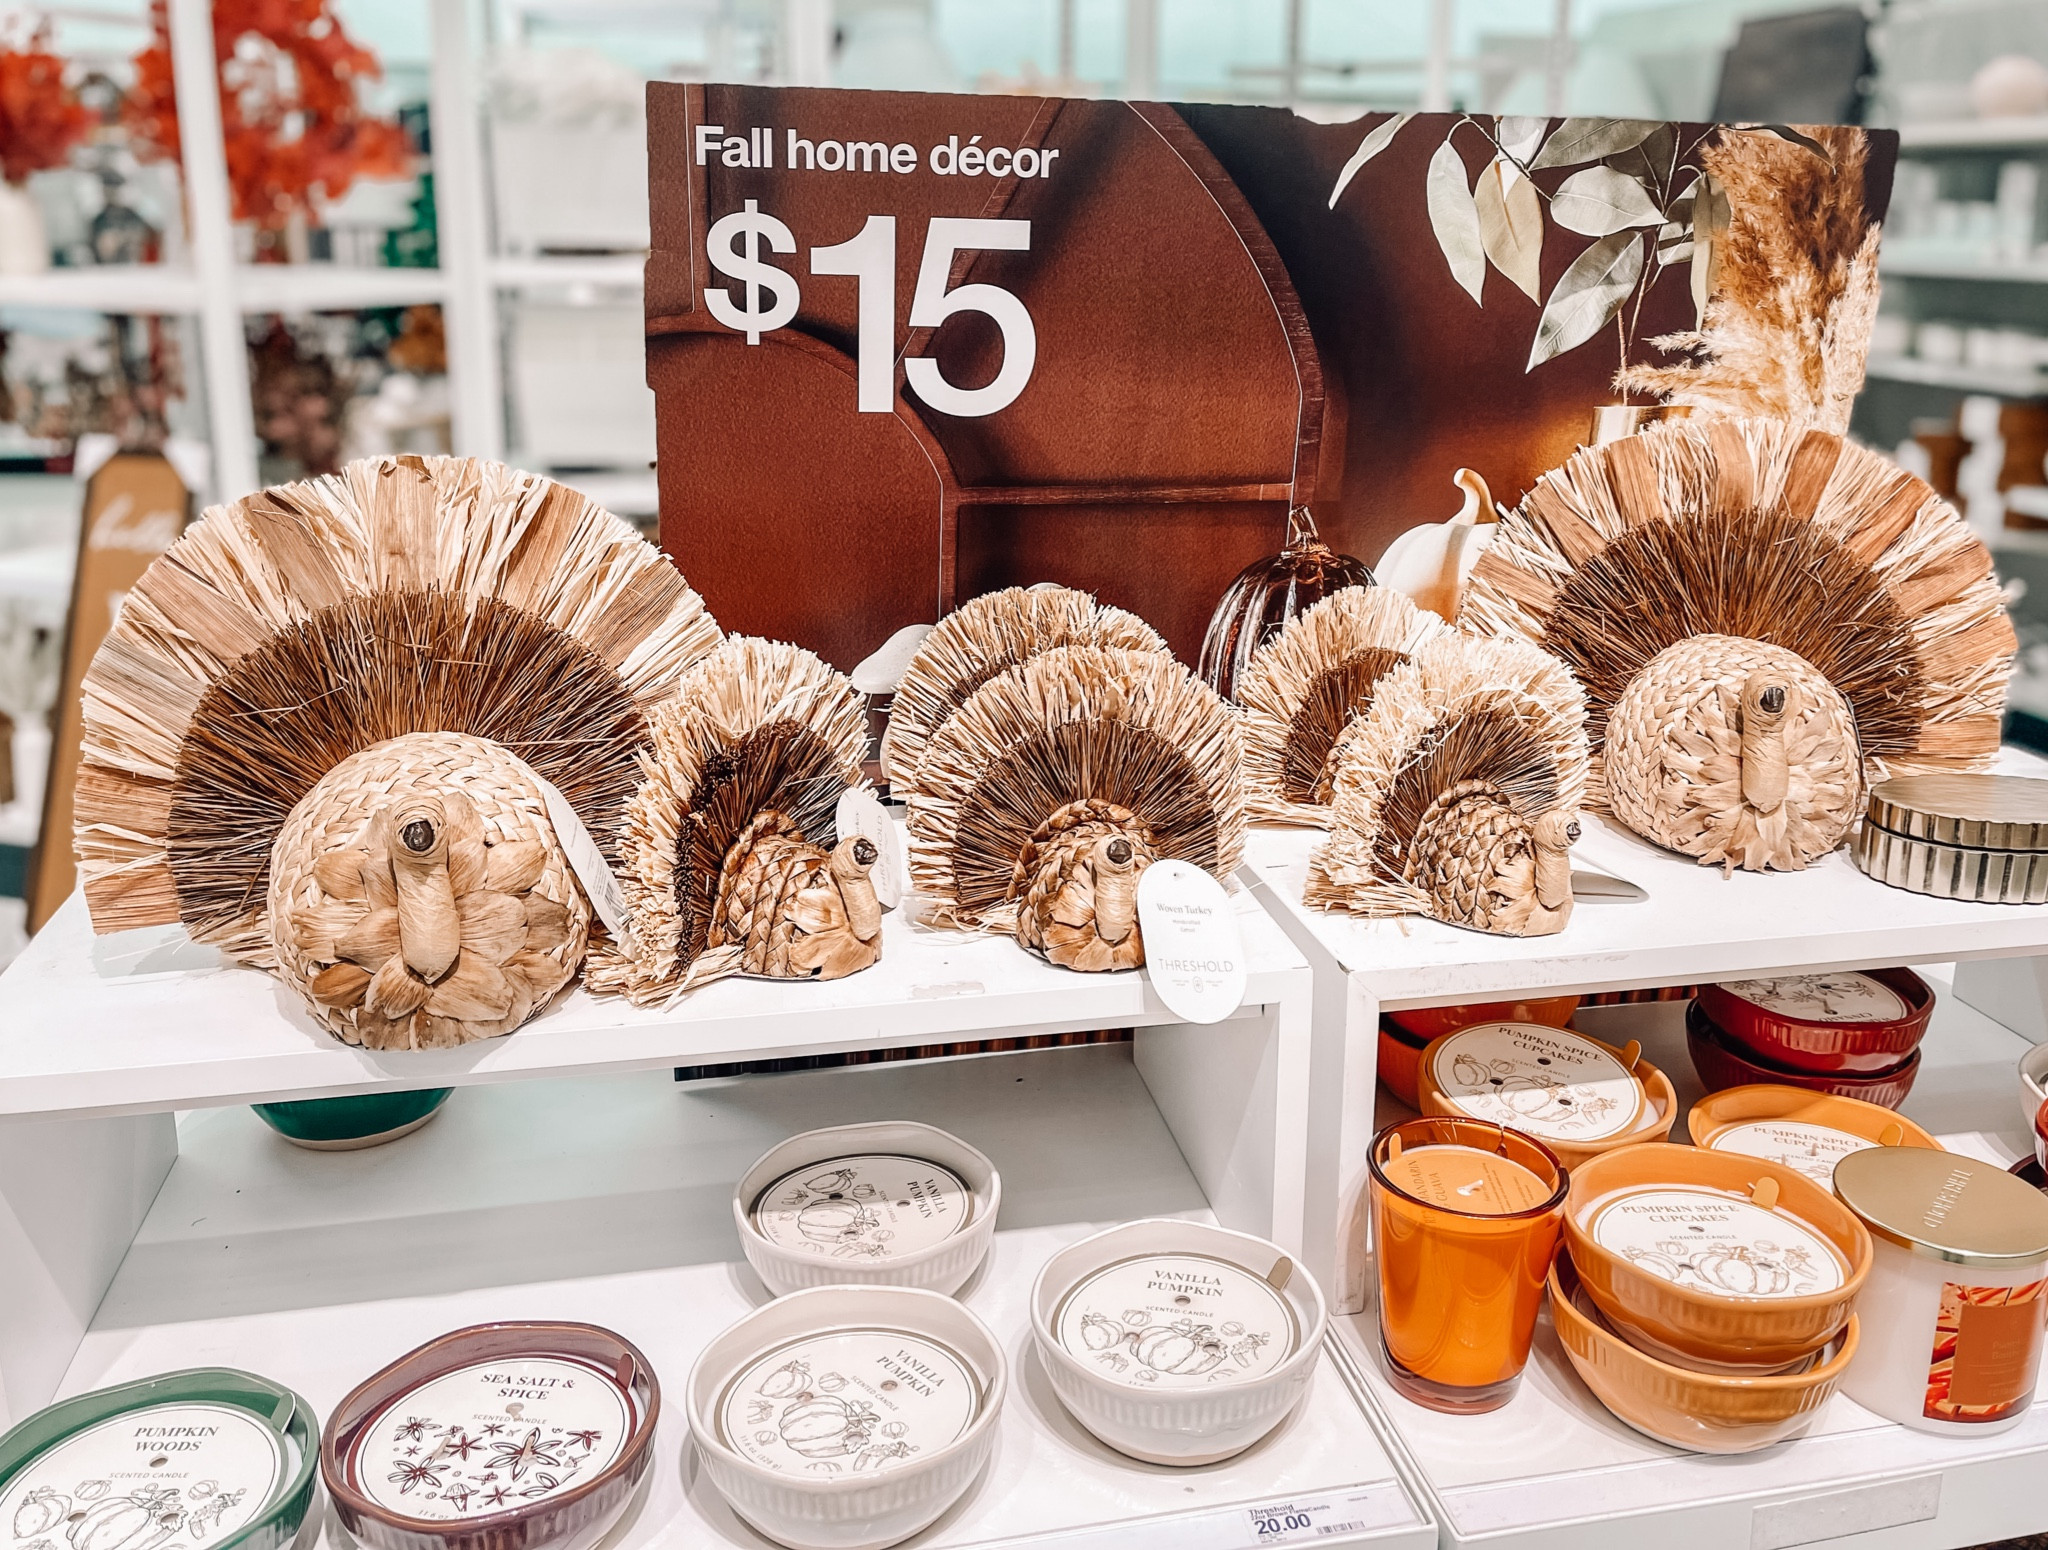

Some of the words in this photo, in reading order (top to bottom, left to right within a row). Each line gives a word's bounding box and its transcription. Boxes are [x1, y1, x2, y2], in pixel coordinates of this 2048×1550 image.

[695, 125, 773, 168] Fall
[787, 128, 917, 174] home
[929, 135, 1059, 178] décor
[704, 199, 1036, 417] $15
[1157, 903, 1183, 914] Woven
[1184, 904, 1213, 916] Turkey
[1158, 958, 1234, 973] THRESHOLD
[1819, 1012, 1873, 1022] CINNAMO
[1498, 1026, 1561, 1049] PUMPKIN
[1563, 1044, 1602, 1062] SPICE
[1512, 1040, 1585, 1066] CUPCAKES
[1511, 1057, 1544, 1072] SCENTED
[1544, 1066, 1571, 1079] CANDLE
[1753, 1127, 1818, 1142] PUMPKIN
[1822, 1136, 1863, 1148] SPICE
[1428, 1172, 1448, 1201] GUAVA
[907, 1181, 934, 1219] PUMPKIN
[924, 1178, 948, 1213] VANILLA
[1620, 1205, 1694, 1213] PUMPKIN
[1695, 1205, 1741, 1213] SPICE
[1649, 1214, 1731, 1223] CUPCAKES
[1155, 1270, 1222, 1286] VANILLA
[1147, 1281, 1224, 1297] PUMPKIN
[1145, 1306, 1181, 1315] SCENTED
[1182, 1310, 1214, 1318] CANDLE
[896, 1350, 945, 1387] VANILLA
[481, 1374, 512, 1385] SEA
[516, 1376, 560, 1388] SALT
[562, 1379, 576, 1389] &
[876, 1356, 936, 1398] PUMPKIN
[497, 1388, 550, 1400] SPICE
[850, 1375, 876, 1396] SCENTED
[874, 1393, 899, 1412] CANDLE
[472, 1413, 511, 1422] SCENTED
[134, 1426, 220, 1437] PUMPKIN
[135, 1441, 202, 1451] WOODS
[1248, 1504, 1295, 1517] Threshold
[1254, 1513, 1312, 1535] 20.00
